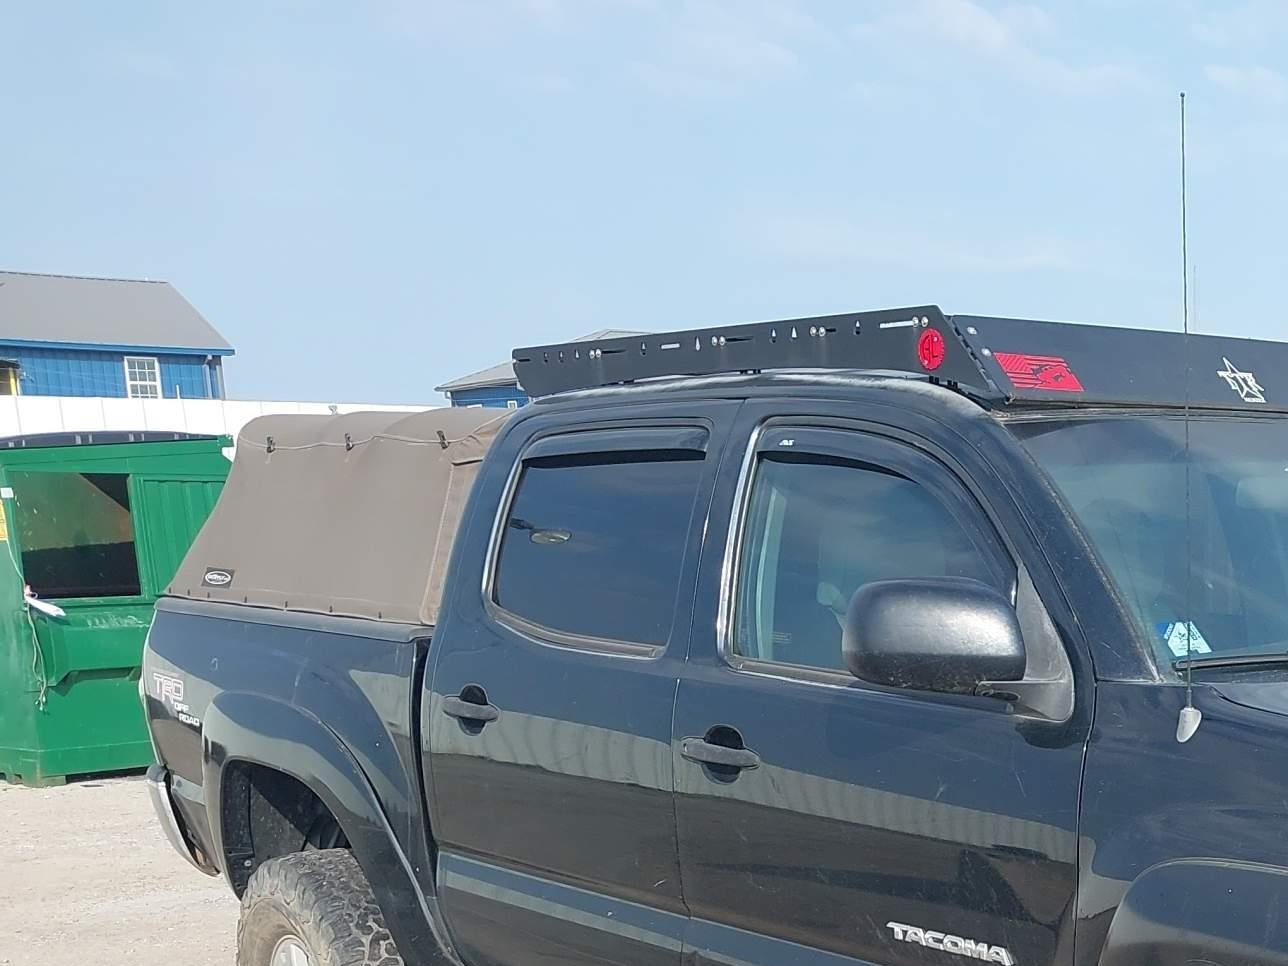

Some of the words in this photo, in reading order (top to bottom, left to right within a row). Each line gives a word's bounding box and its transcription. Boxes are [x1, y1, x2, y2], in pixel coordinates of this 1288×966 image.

[153, 672, 184, 705] TRD
[174, 702, 189, 713] OFF
[178, 712, 200, 727] ROAD
[886, 921, 1014, 966] TACOMA
